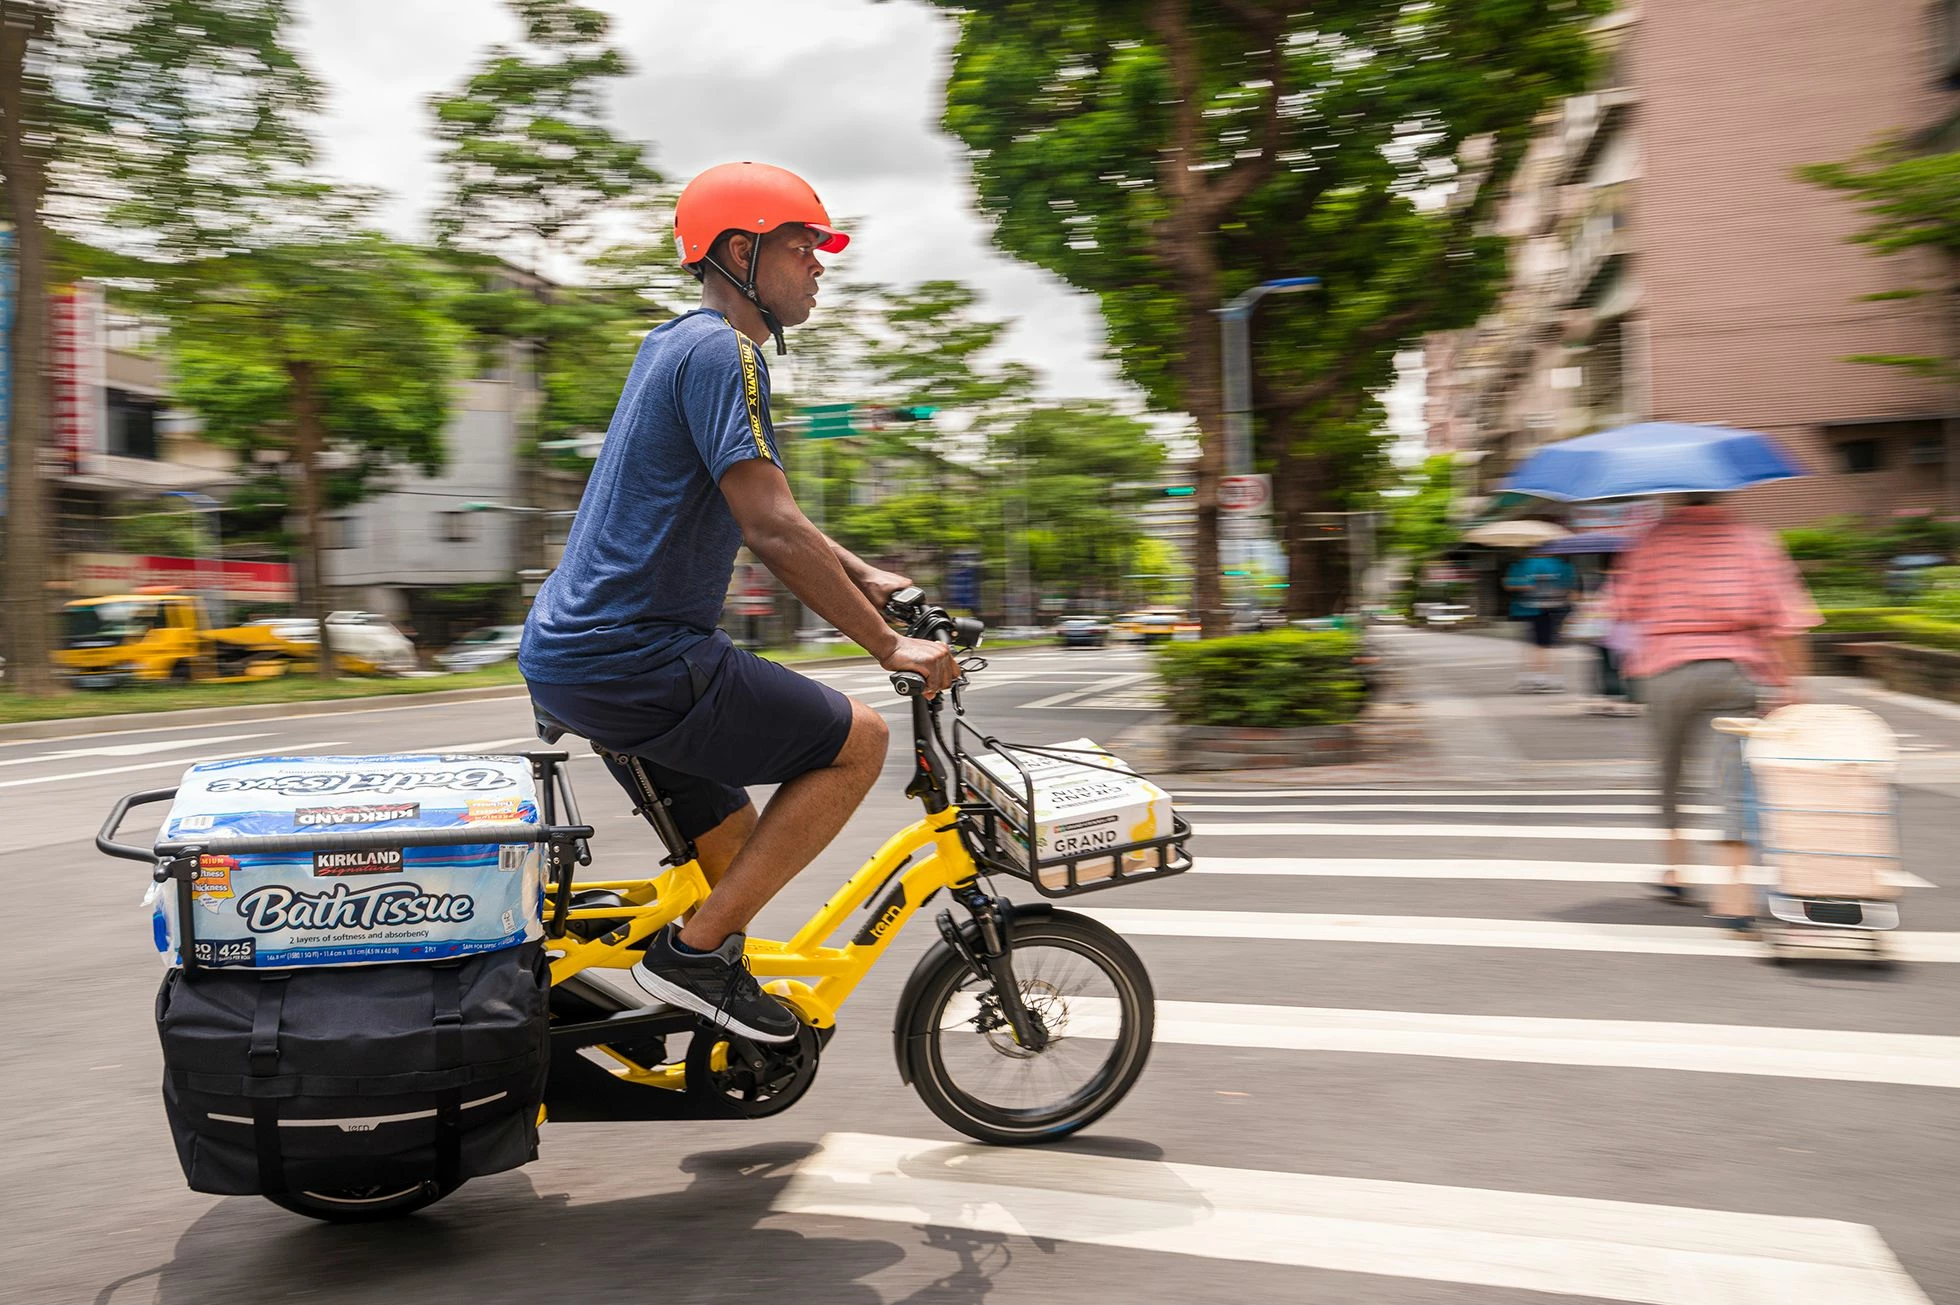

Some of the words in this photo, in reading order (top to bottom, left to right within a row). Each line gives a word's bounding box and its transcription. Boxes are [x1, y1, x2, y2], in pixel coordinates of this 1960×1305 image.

[745, 365, 757, 396] XIANG
[299, 808, 414, 825] KIRKLAND
[1055, 830, 1117, 852] GRAND
[318, 851, 400, 867] KIRKLAND
[869, 905, 902, 938] tern
[289, 936, 294, 944] 2
[297, 935, 320, 944] layers
[333, 933, 366, 941] softness
[368, 931, 383, 939] and
[384, 929, 429, 939] absorbency
[219, 942, 251, 957] 425
